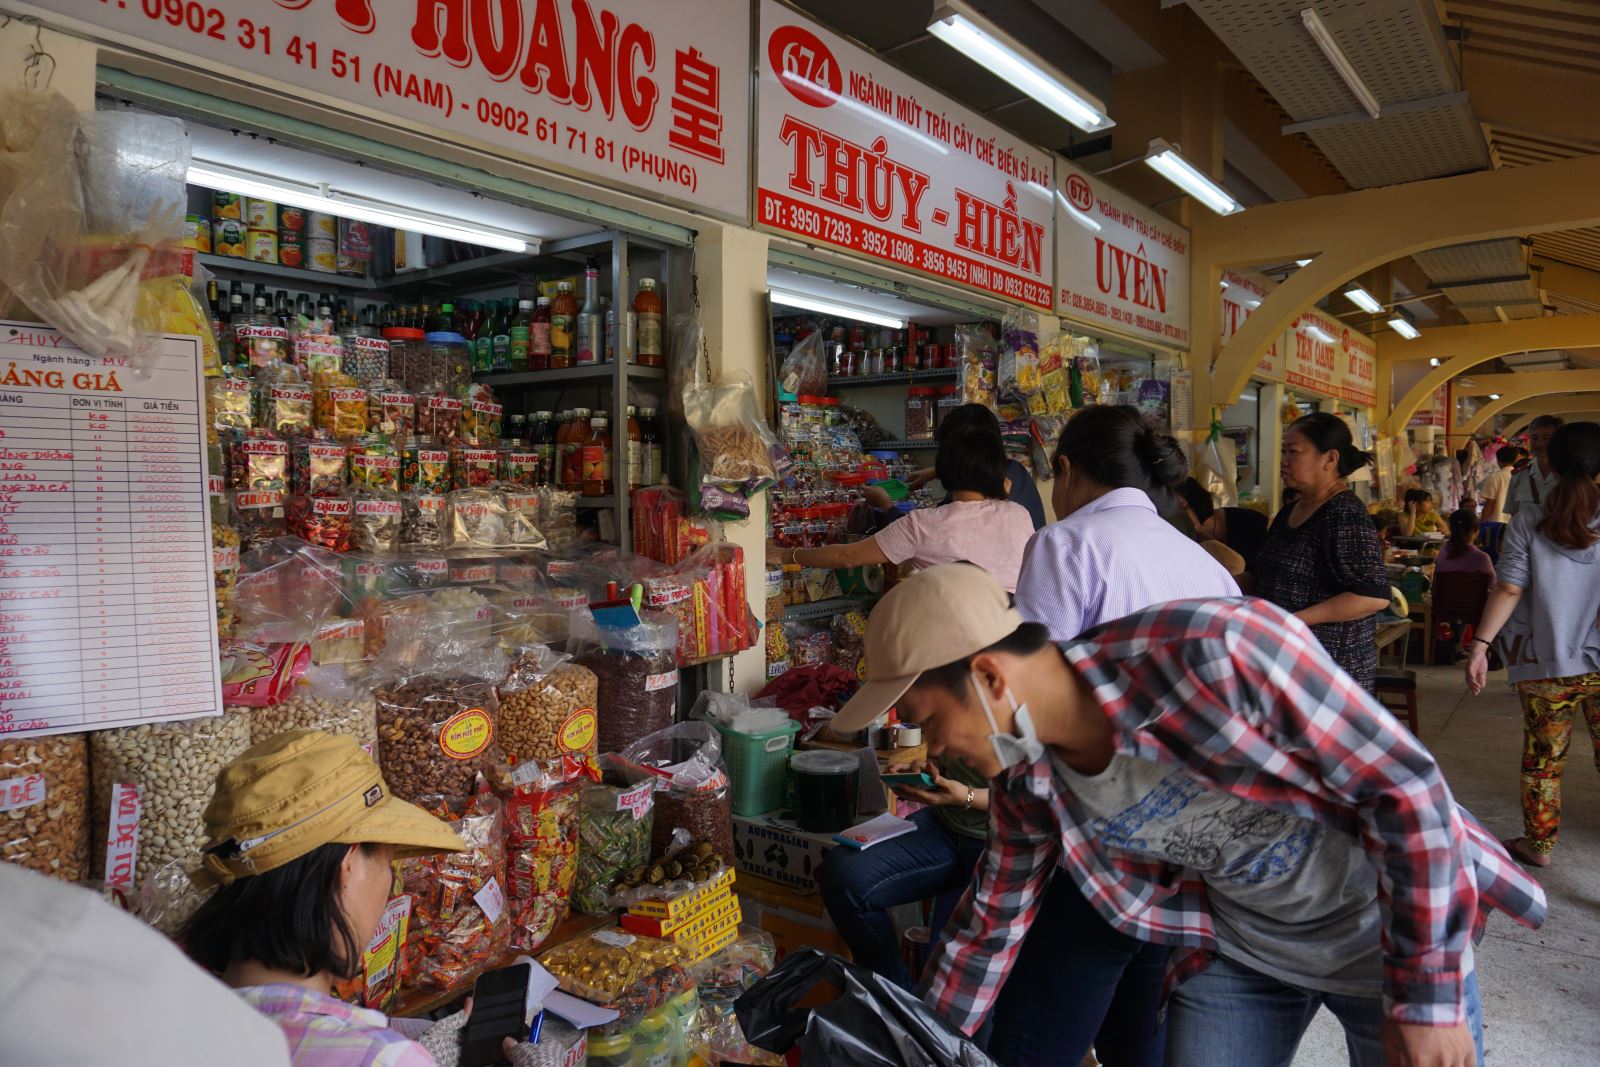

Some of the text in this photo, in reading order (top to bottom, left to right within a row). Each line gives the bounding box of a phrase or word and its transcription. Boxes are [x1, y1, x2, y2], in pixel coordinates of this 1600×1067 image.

[782, 42, 831, 91] 674
[142, 0, 226, 41] 0902
[237, 19, 271, 54] 31
[286, 36, 317, 69] 41
[331, 50, 361, 82] 51
[373, 63, 453, 117] (NAM)
[477, 98, 529, 136] 0902
[536, 117, 559, 144] 61
[566, 127, 587, 153] 71
[595, 137, 615, 162] 81
[622, 145, 697, 193] (PHỤNG)
[669, 46, 724, 164] 皇
[849, 70, 893, 115] NGÀNH
[896, 94, 923, 126] MỨT
[926, 112, 951, 143] TRÁI
[953, 125, 974, 155] CÂY
[976, 137, 996, 166] CHẾ
[998, 147, 1018, 178] BIẾN
[1031, 167, 1037, 183] &
[779, 114, 931, 234] THÚY
[954, 180, 1046, 277] HIỀN
[1070, 180, 1090, 206] 673
[765, 197, 787, 222] ĐT:
[790, 204, 820, 235] 3950
[824, 215, 851, 245] 7293
[862, 229, 888, 256] 3952
[891, 239, 914, 264] 1608
[923, 249, 945, 274] 3856
[947, 259, 968, 281] 9453
[1006, 279, 1023, 299] 0932
[1025, 285, 1038, 303] 622
[1038, 289, 1050, 307] 226
[1094, 241, 1168, 314] UYÊN
[0, 362, 123, 391] ẢNG GIÁ
[33, 354, 64, 365] Ngành
[67, 355, 90, 367] hàng
[73, 398, 123, 409] ĐƠN VỊ TÍNH
[143, 401, 179, 411] GIÁ TIỀN
[748, 825, 809, 850] AUSTRALIAN
[743, 861, 815, 889] TABLE GRAPES
